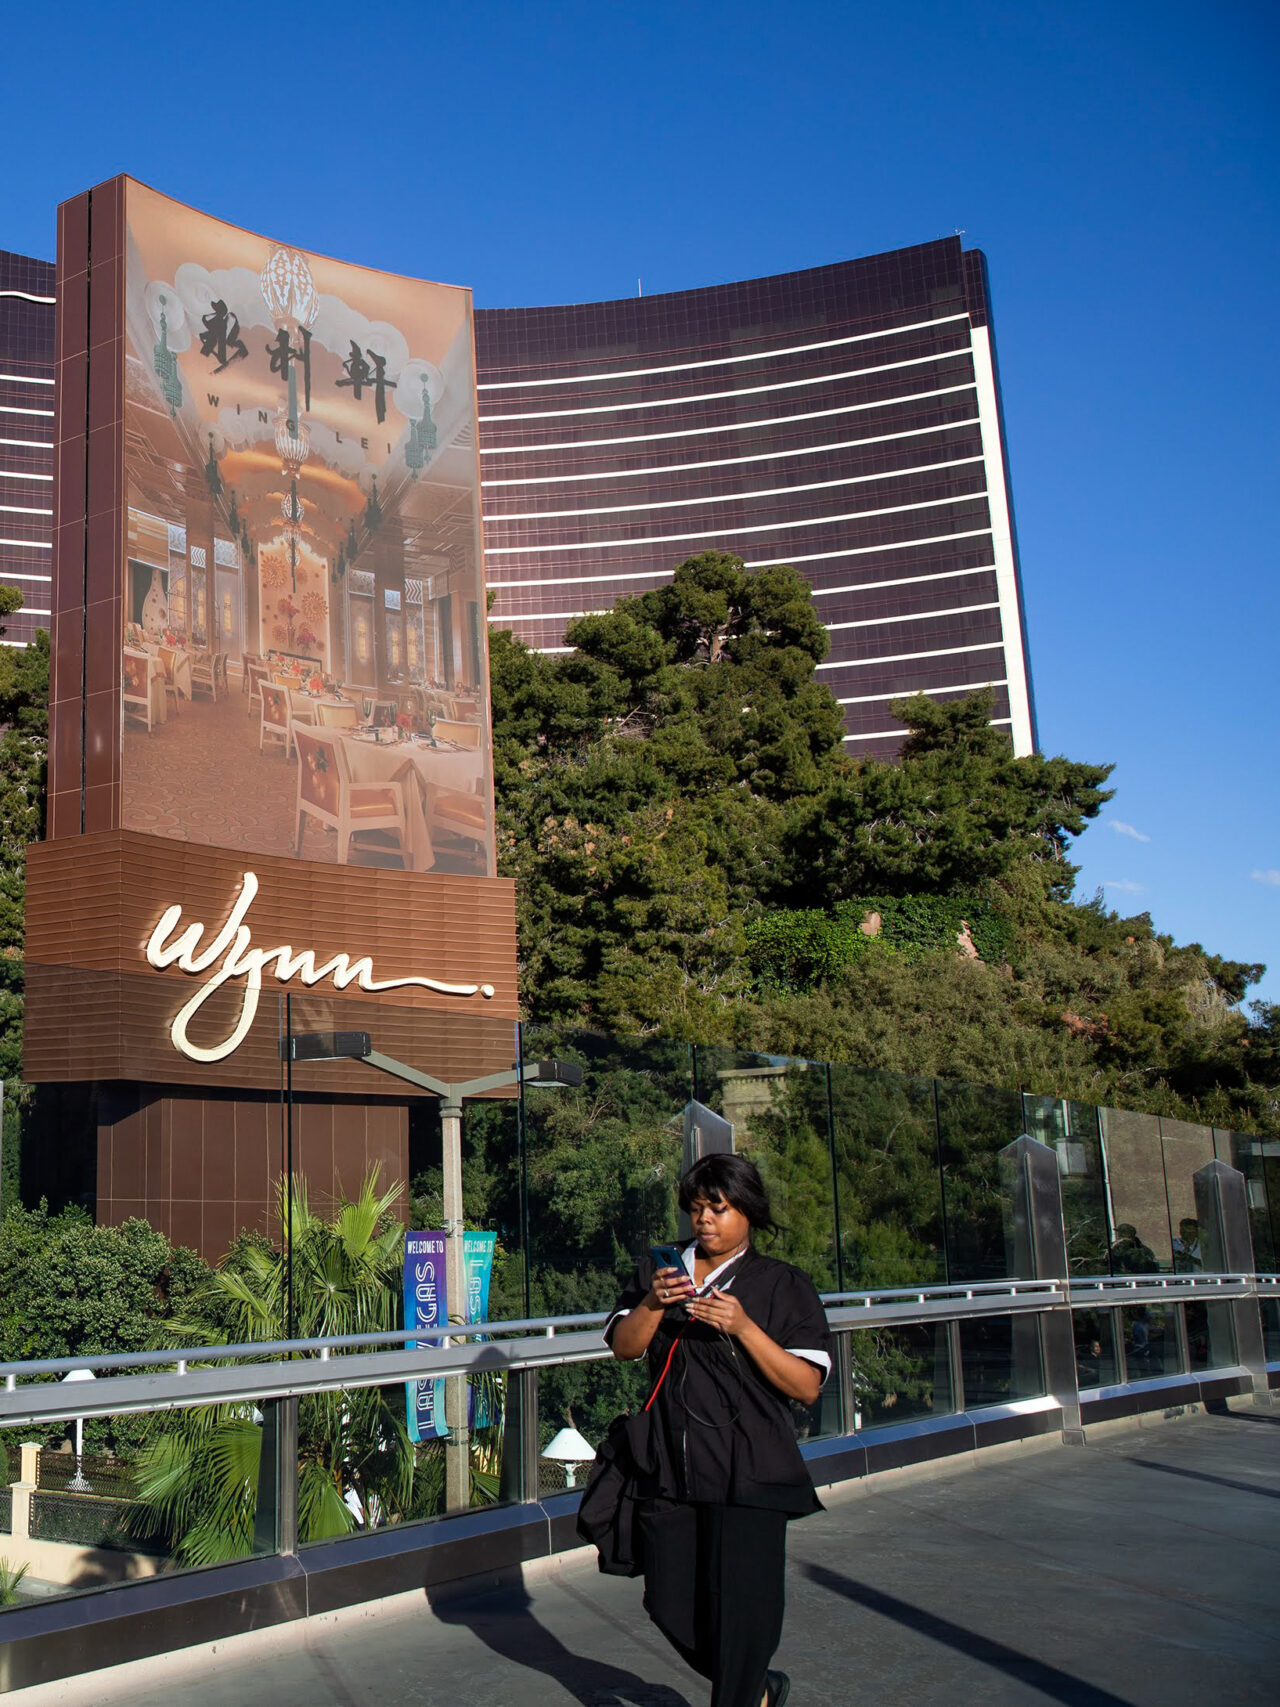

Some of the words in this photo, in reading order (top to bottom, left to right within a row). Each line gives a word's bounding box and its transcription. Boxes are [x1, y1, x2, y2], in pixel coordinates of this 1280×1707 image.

[207, 393, 297, 432] WING
[336, 432, 392, 454] LEI
[407, 1240, 435, 1254] WELCOME
[435, 1240, 444, 1254] TO
[464, 1240, 487, 1253] WELCOME
[469, 1259, 484, 1315] LAS
